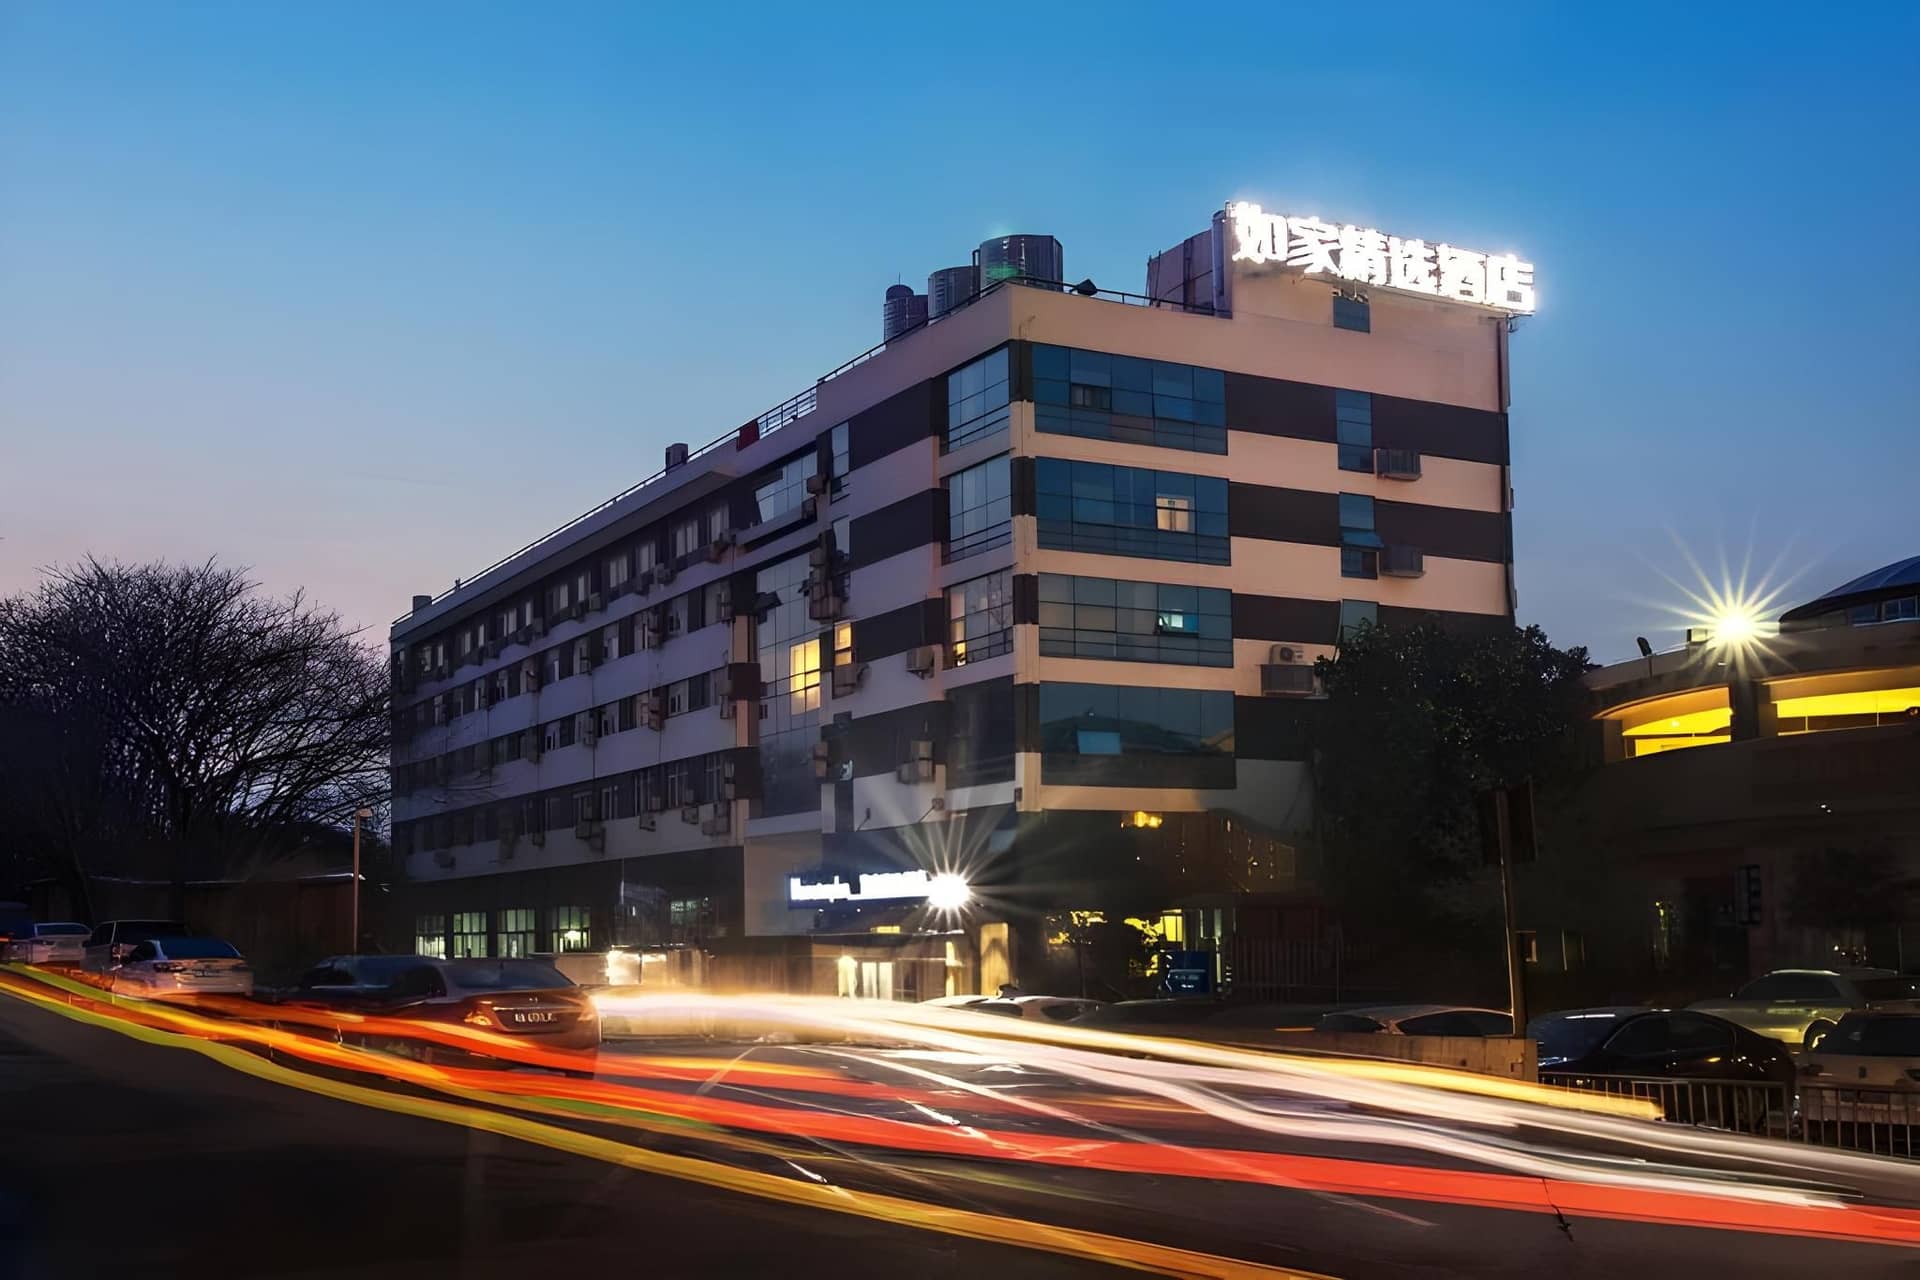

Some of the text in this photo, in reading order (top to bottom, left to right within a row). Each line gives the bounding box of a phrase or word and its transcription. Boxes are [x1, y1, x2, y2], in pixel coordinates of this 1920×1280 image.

[1232, 202, 1535, 311] 如家精选酒店
